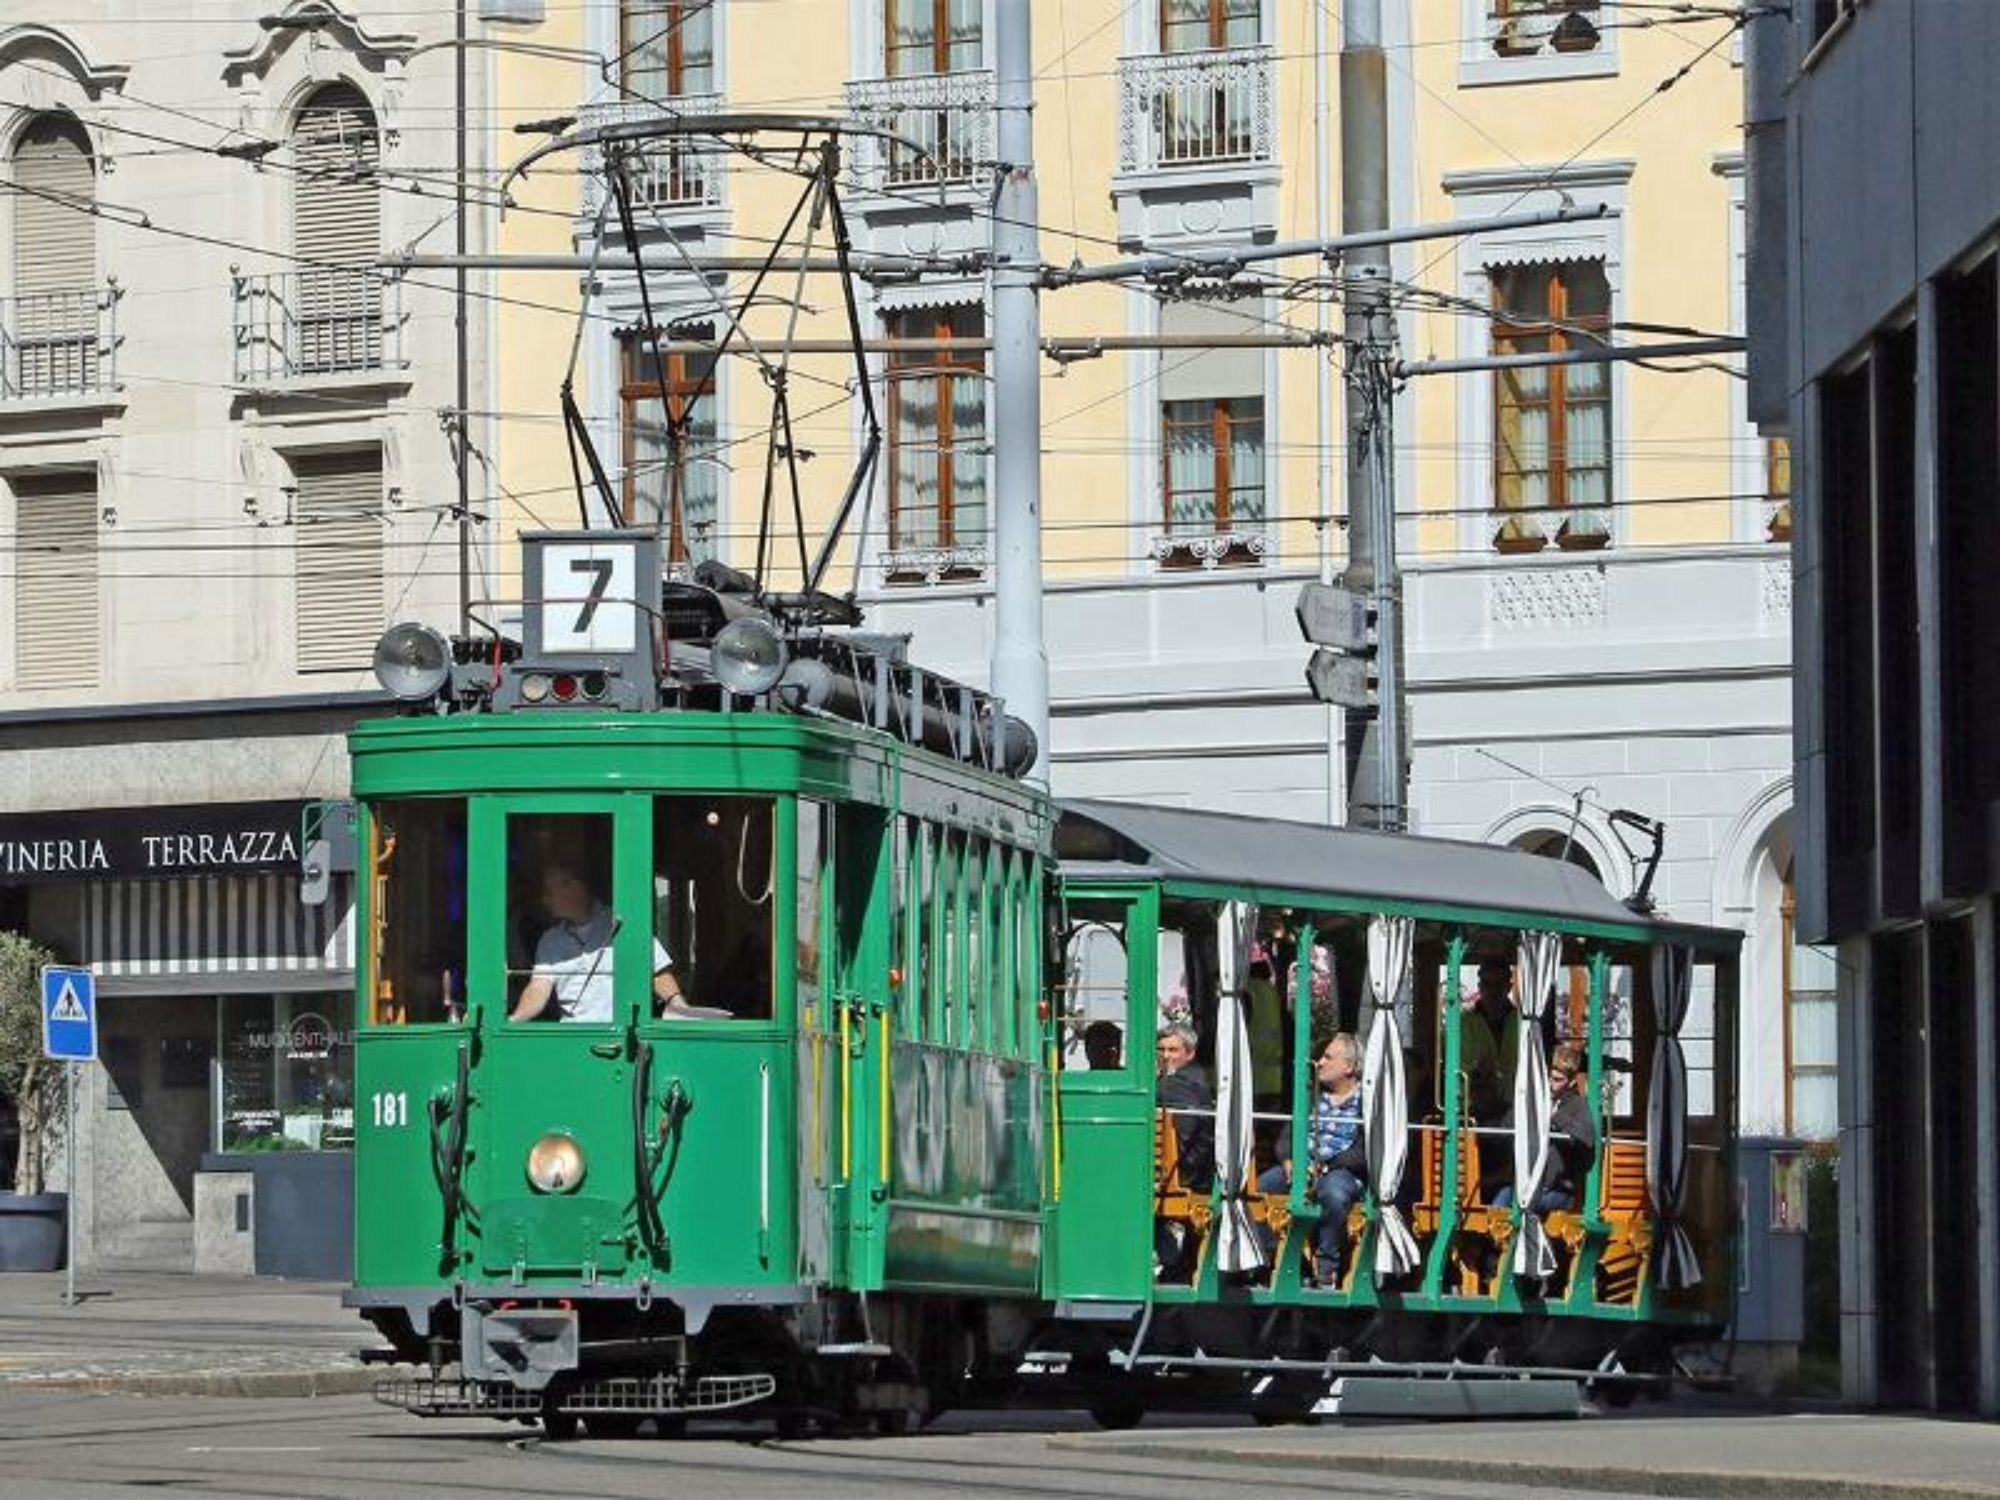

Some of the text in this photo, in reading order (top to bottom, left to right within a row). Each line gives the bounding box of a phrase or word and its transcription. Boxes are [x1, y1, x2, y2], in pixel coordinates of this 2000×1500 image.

[570, 559, 613, 633] 7
[142, 831, 298, 867] TERRAZZA
[372, 1091, 406, 1126] 181
